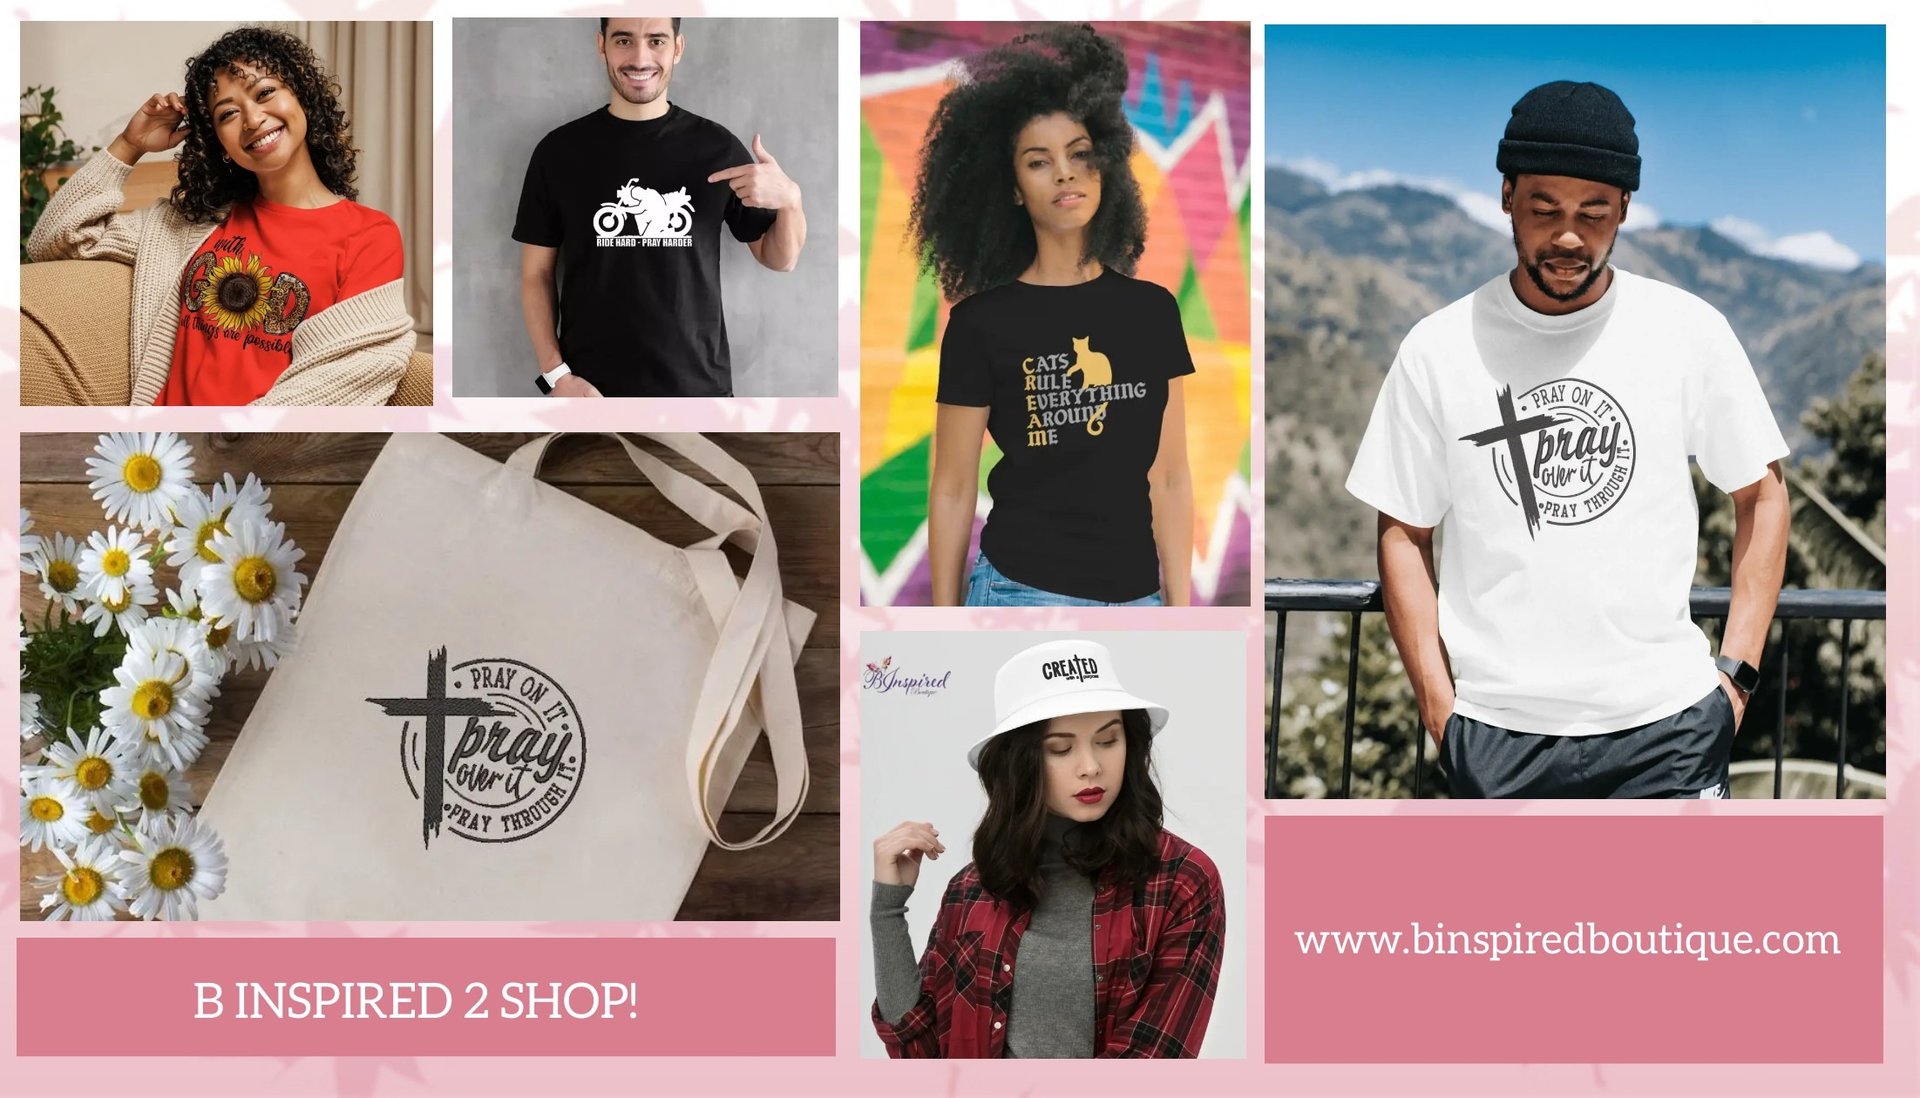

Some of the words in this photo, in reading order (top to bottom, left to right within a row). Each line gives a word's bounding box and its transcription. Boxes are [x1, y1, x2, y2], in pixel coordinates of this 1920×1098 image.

[214, 236, 245, 254] with
[596, 238, 614, 247] RIDE
[615, 238, 636, 247] HARD
[642, 238, 661, 247] PRAY
[662, 238, 693, 247] HARDER
[192, 316, 219, 341] things
[223, 328, 241, 341] are
[1022, 353, 1069, 375] CATS
[1024, 373, 1072, 391] RULE
[1025, 382, 1147, 412] EVERYTHING
[1531, 385, 1566, 409] PRAY
[1571, 386, 1594, 407] ON
[1593, 400, 1613, 418] IT
[1027, 405, 1107, 429] AROUND
[1027, 428, 1059, 447] ME
[1533, 422, 1621, 479] pray
[1542, 464, 1578, 488] over
[1580, 455, 1598, 484] it
[1543, 501, 1578, 518] PRAY
[1584, 465, 1628, 513] THROUGH
[1617, 446, 1630, 460] IT
[1042, 654, 1098, 682] CREATED
[471, 666, 517, 690] PRAY
[520, 676, 549, 704] ON
[543, 700, 569, 724] IT
[448, 716, 573, 783] pray
[456, 763, 504, 792] over
[505, 764, 532, 800] it
[448, 803, 492, 833] PRAY
[501, 782, 568, 833] THROUGH
[556, 762, 576, 781] IT
